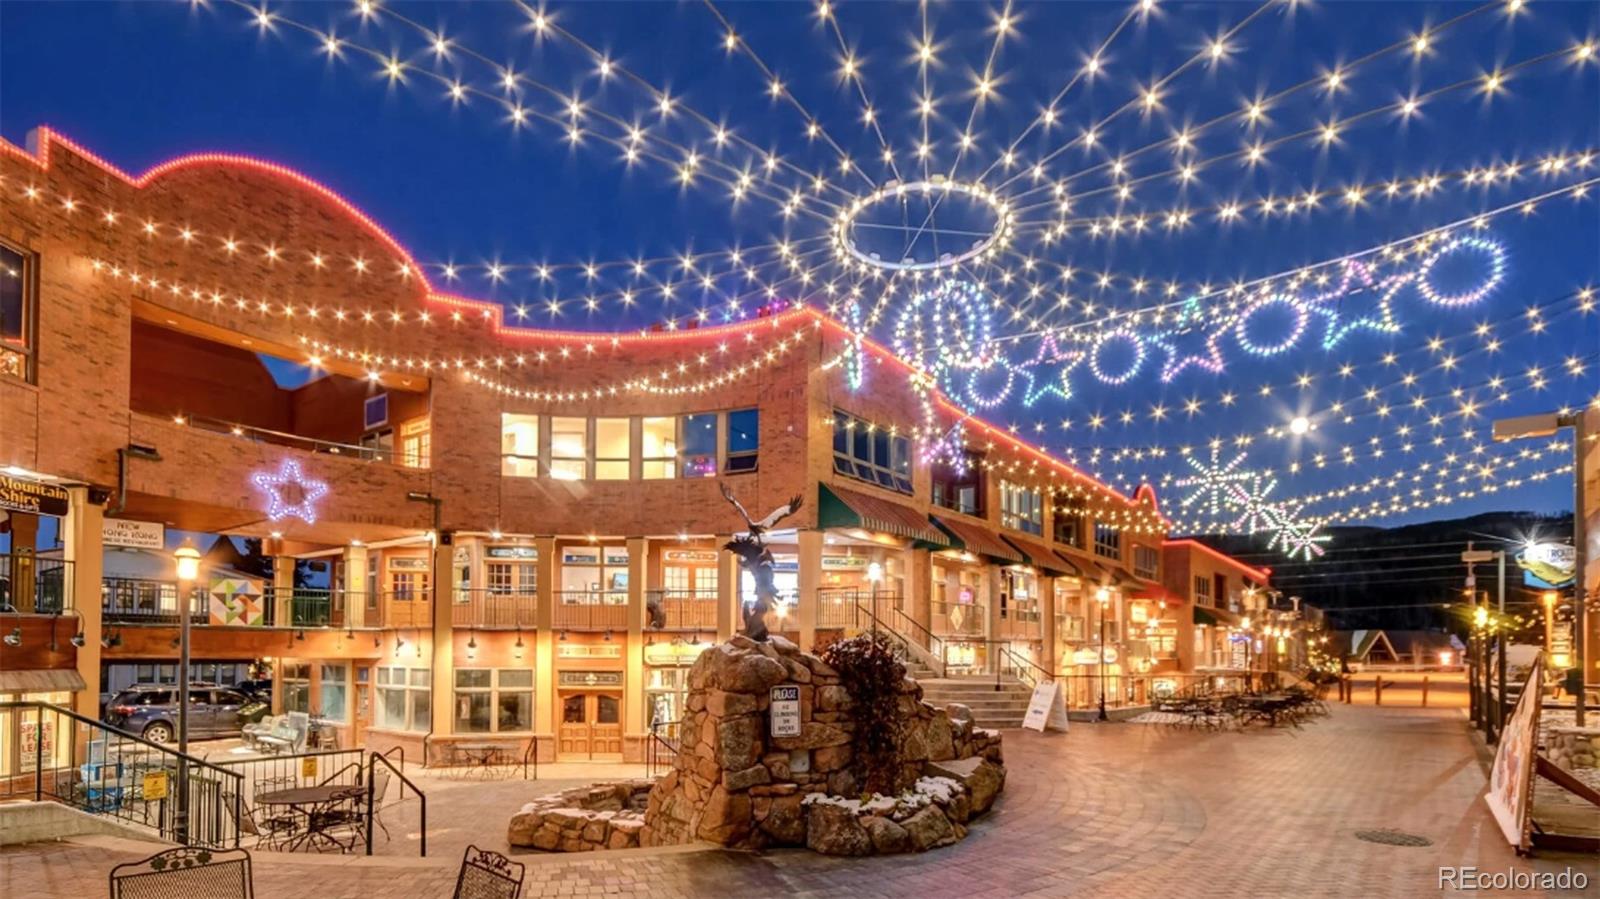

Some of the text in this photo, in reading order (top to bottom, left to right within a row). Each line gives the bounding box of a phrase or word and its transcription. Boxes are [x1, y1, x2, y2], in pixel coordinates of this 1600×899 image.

[0, 476, 68, 500] Mountain
[0, 488, 40, 505] Shire
[773, 688, 797, 700] PLEASE
